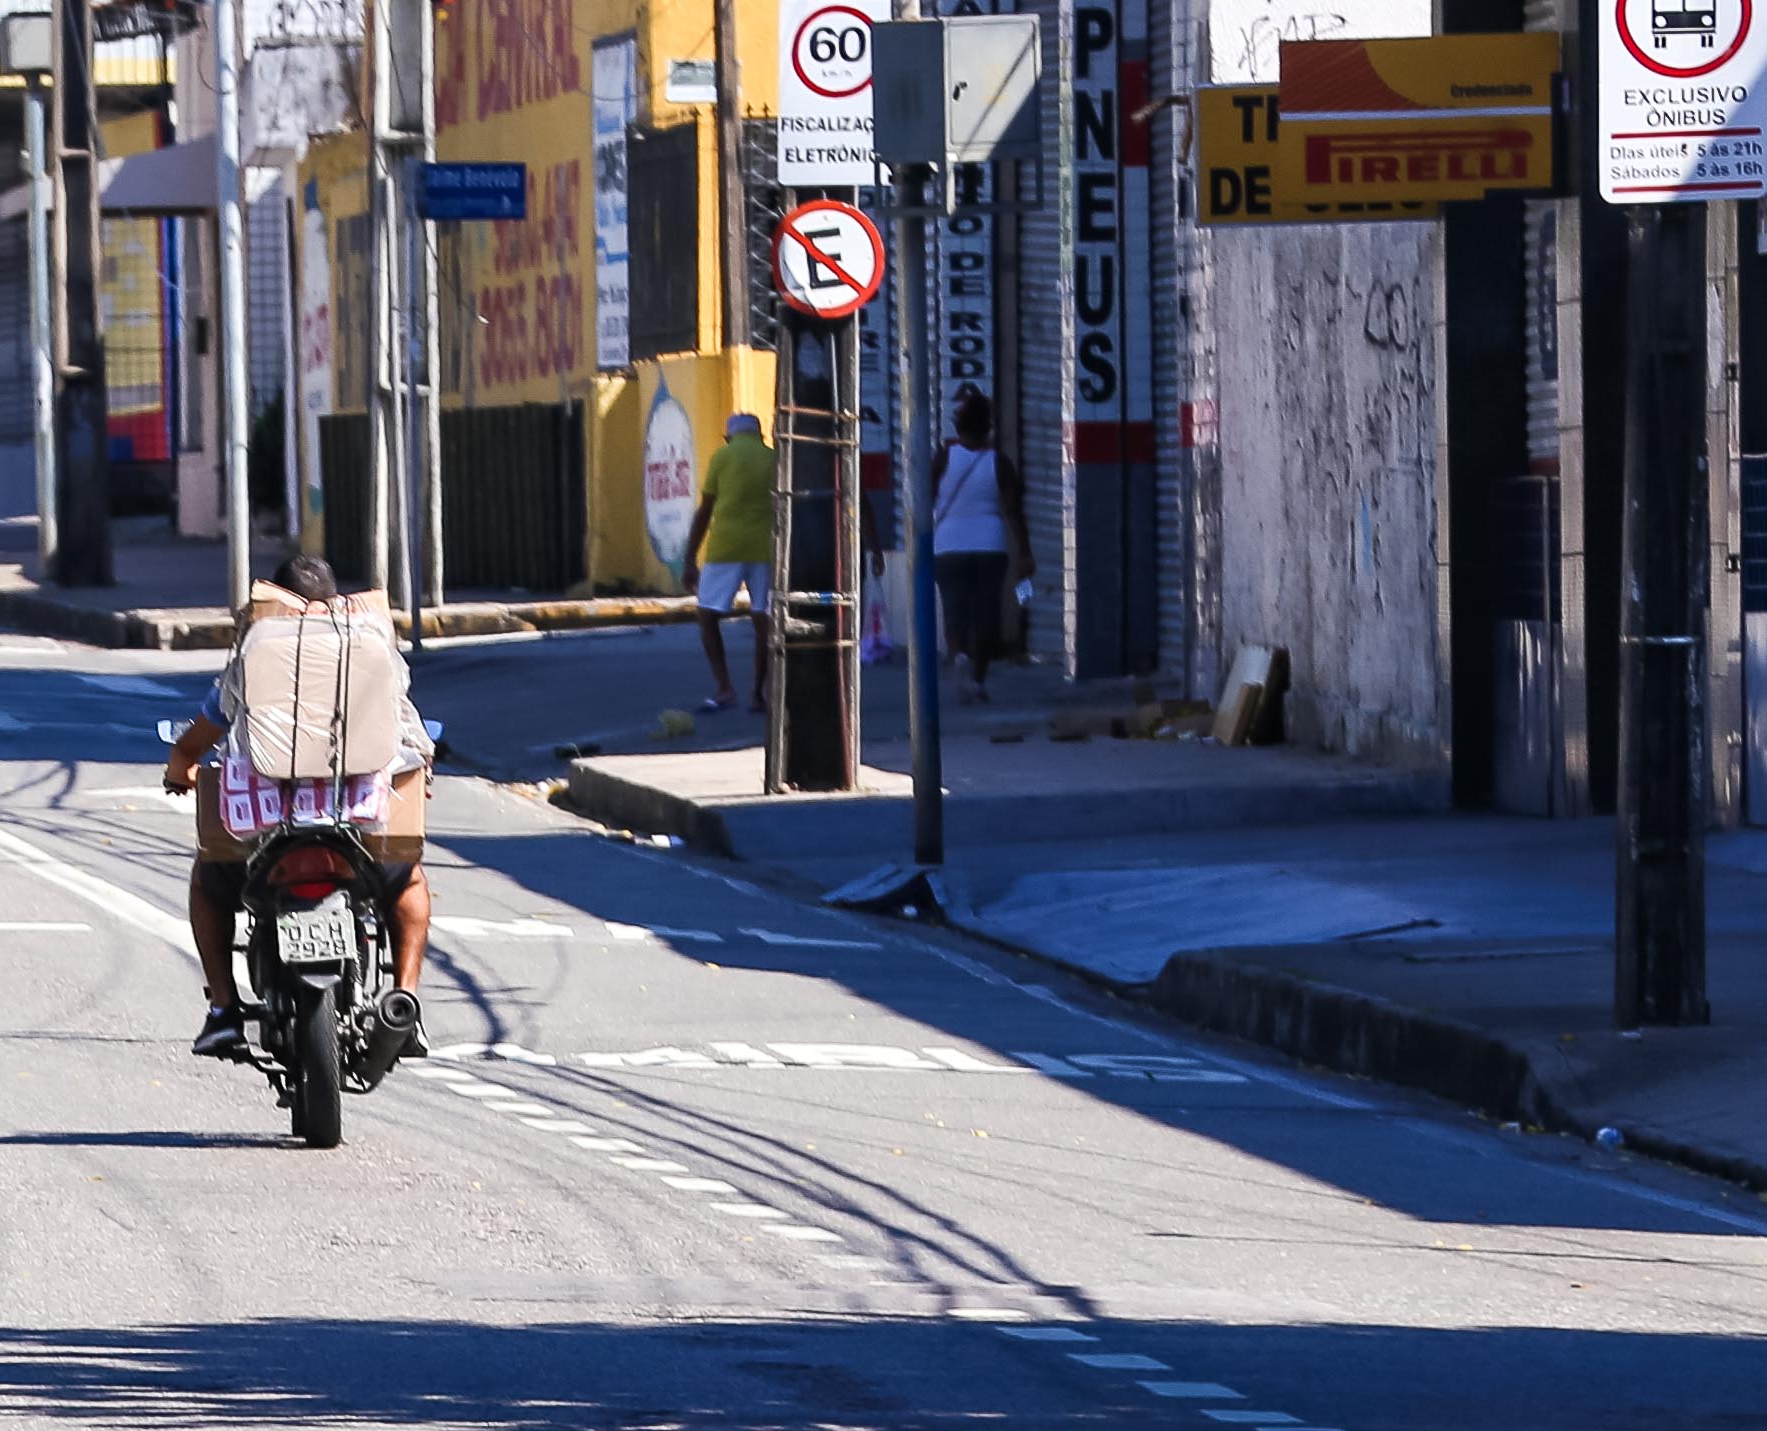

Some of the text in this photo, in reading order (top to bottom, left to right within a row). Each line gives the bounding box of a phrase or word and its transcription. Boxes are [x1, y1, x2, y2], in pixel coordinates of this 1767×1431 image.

[809, 26, 866, 62] 60
[1623, 85, 1749, 106] EXCLUSIVO
[780, 116, 874, 134] FISCALIZAÇ
[785, 144, 877, 163] ELETRÔNIC
[1305, 129, 1533, 185] PIRELLI
[1610, 146, 1645, 160] Dias
[1697, 145, 1706, 158] 5
[1710, 143, 1729, 157] às
[1733, 141, 1763, 156] 21h
[1610, 161, 1763, 180] Sábados 5 às 16h
[1075, 7, 1117, 403] PNEUS
[1210, 166, 1271, 216] DE
[803, 228, 842, 288] E
[950, 313, 984, 403] RODA
